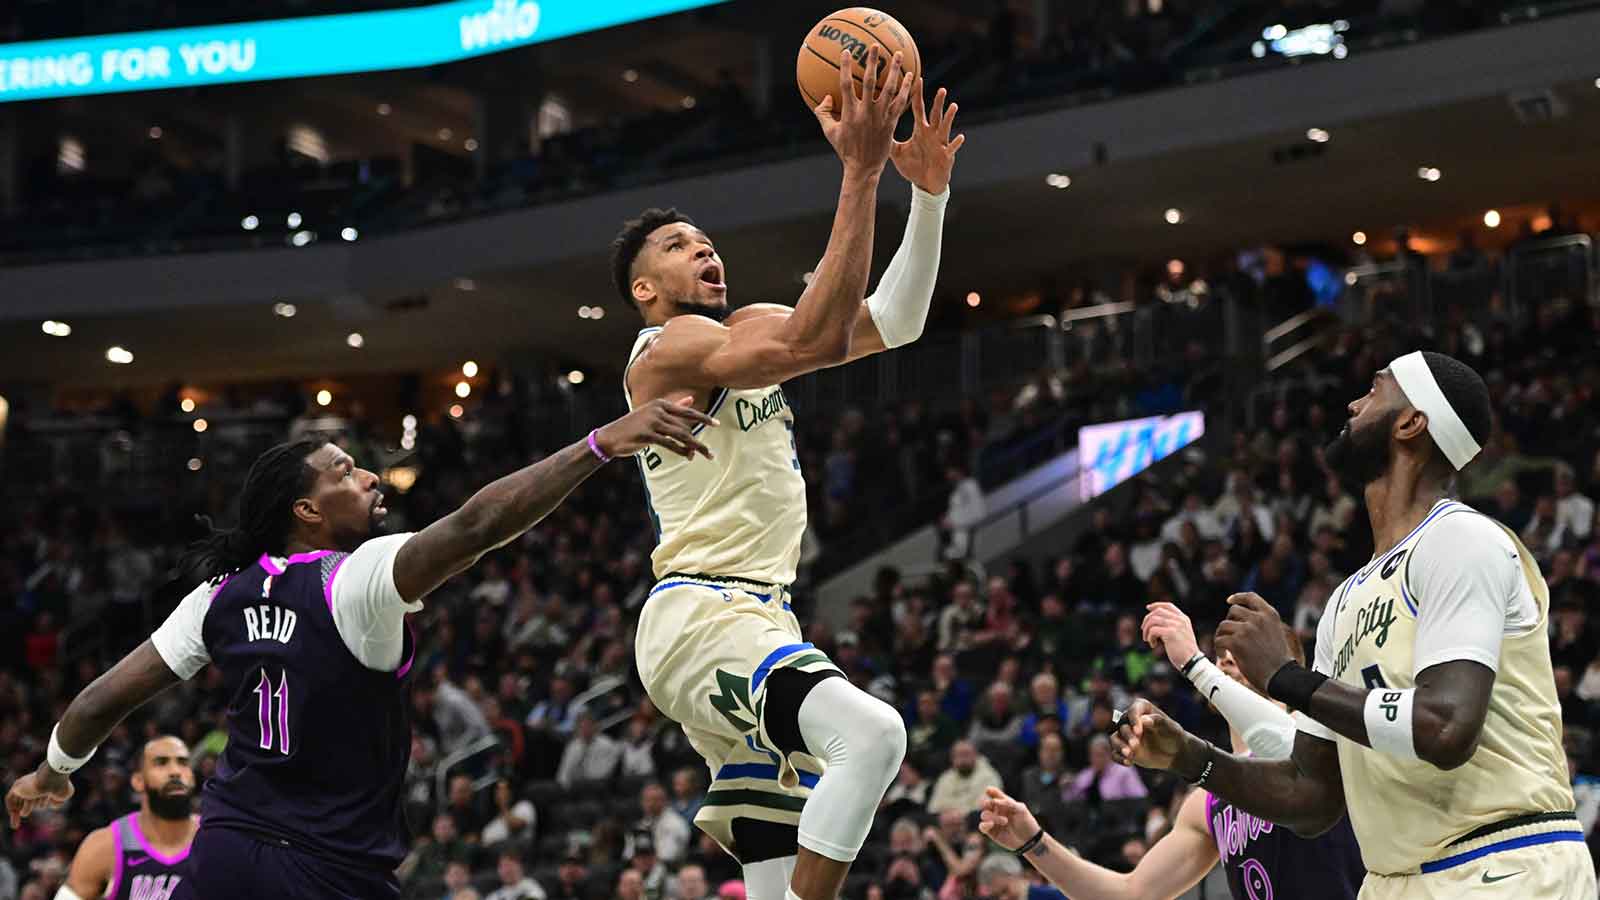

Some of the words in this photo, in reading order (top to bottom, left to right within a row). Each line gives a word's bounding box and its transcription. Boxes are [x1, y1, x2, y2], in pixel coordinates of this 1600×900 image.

[101, 46, 171, 82] FOR
[179, 39, 257, 75] YOU
[243, 604, 297, 644] REID
[1355, 595, 1397, 648] City
[253, 667, 290, 756] 11
[1378, 692, 1402, 722] BP
